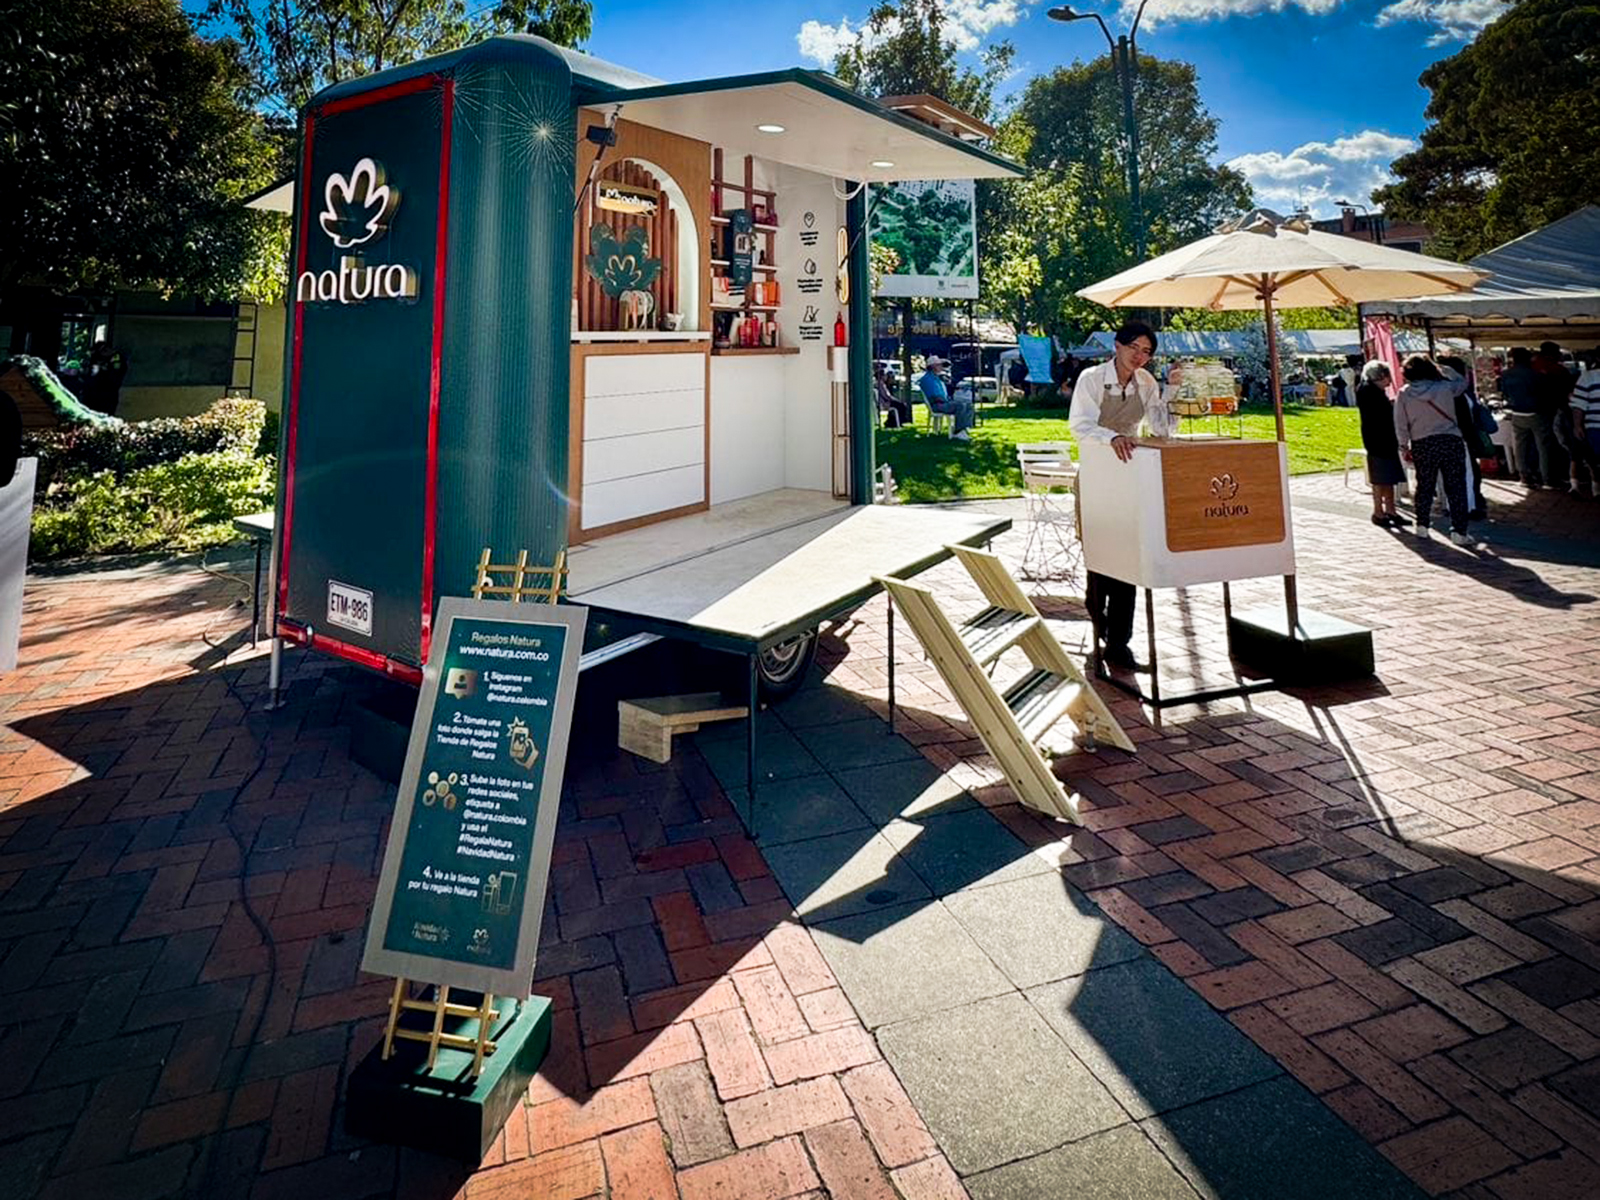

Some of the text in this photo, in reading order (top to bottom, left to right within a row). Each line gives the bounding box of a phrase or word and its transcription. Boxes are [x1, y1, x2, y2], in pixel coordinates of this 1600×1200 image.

[297, 256, 409, 304] natura
[1204, 502, 1249, 518] natura
[471, 631, 541, 648] Regalos Natura
[459, 645, 549, 662] www.natura.com.co
[488, 682, 523, 693] Instagram
[523, 676, 533, 684] en
[486, 692, 548, 706] @natura.colombia
[488, 719, 502, 728] una
[451, 725, 473, 735] donde
[474, 728, 492, 739] salga
[437, 734, 498, 750] Tienda de Regalos
[471, 749, 496, 761] Natura
[460, 773, 469, 786] 3.
[469, 774, 489, 785] Sube
[496, 777, 511, 788] foto
[511, 780, 521, 788] en
[521, 781, 534, 791] tus
[467, 787, 488, 797] redes
[465, 798, 495, 810] etiqueta
[463, 809, 527, 826] @natura.colombia
[466, 823, 480, 832] usa
[459, 833, 513, 849] #RegalaNatura
[456, 845, 515, 862] #NavidadNatura
[422, 865, 480, 885] 4. Ve a la tienda
[408, 880, 478, 898] por tu regalo Natura
